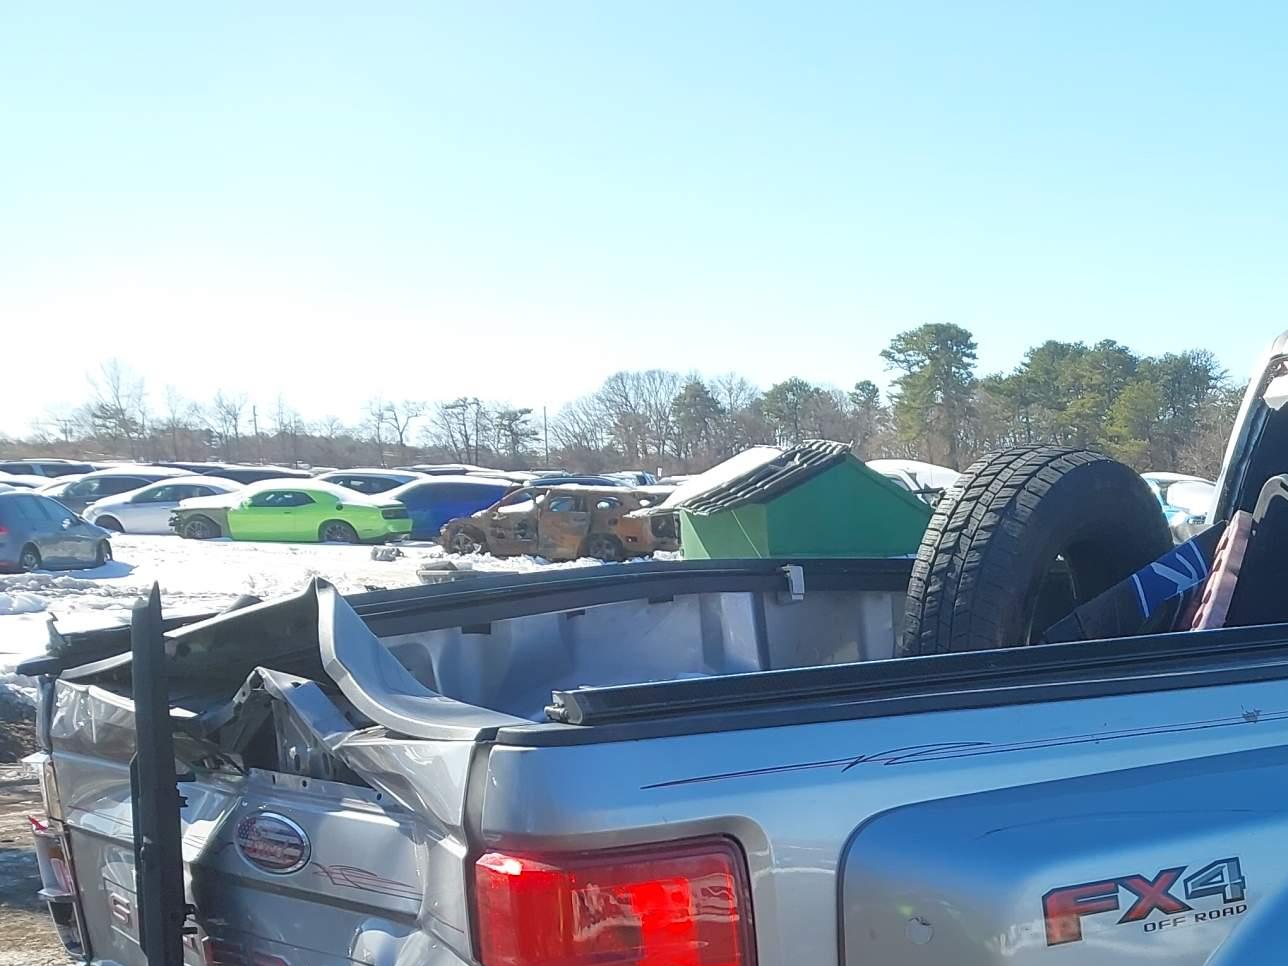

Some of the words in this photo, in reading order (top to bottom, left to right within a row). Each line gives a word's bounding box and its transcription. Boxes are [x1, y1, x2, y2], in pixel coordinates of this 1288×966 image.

[1042, 856, 1246, 946] FX4
[1143, 915, 1186, 934] OFF
[1194, 904, 1248, 923] ROAD
